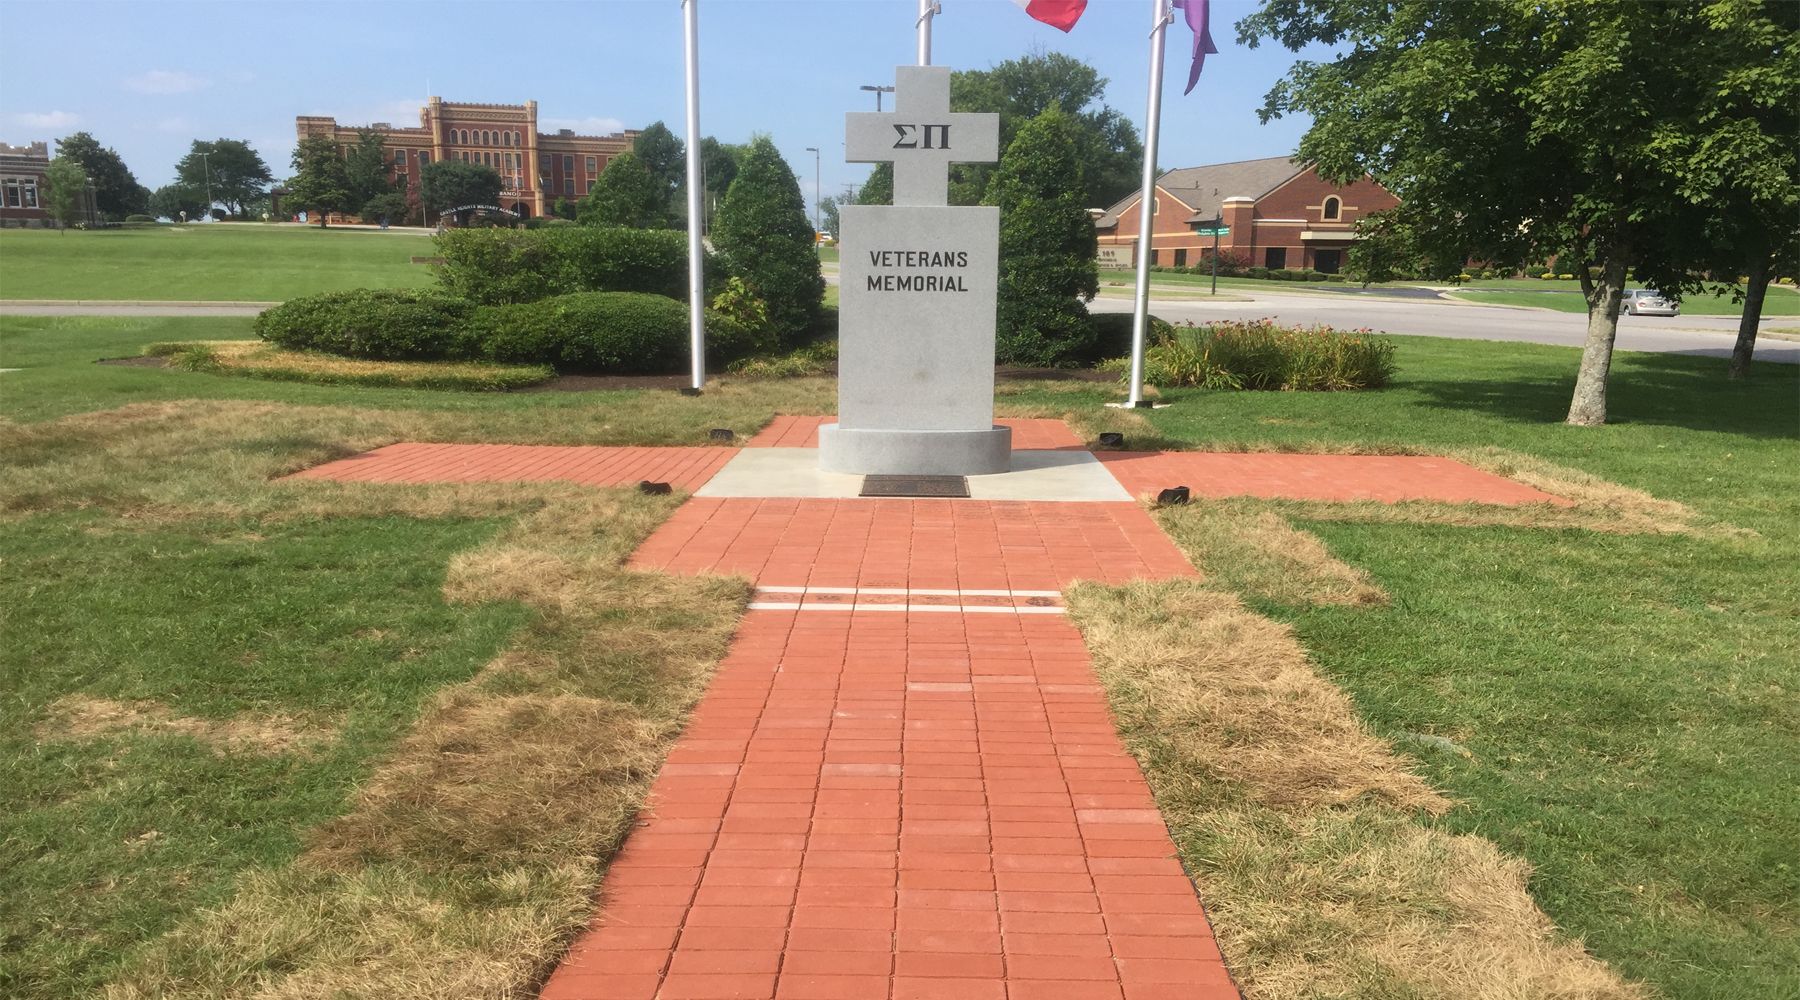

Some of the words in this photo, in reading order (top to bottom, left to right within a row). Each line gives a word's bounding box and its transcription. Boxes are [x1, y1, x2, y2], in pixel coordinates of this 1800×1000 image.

[892, 124, 952, 150] ΣΠ
[869, 250, 968, 268] VETERANS
[867, 275, 968, 292] MEMORIAL
